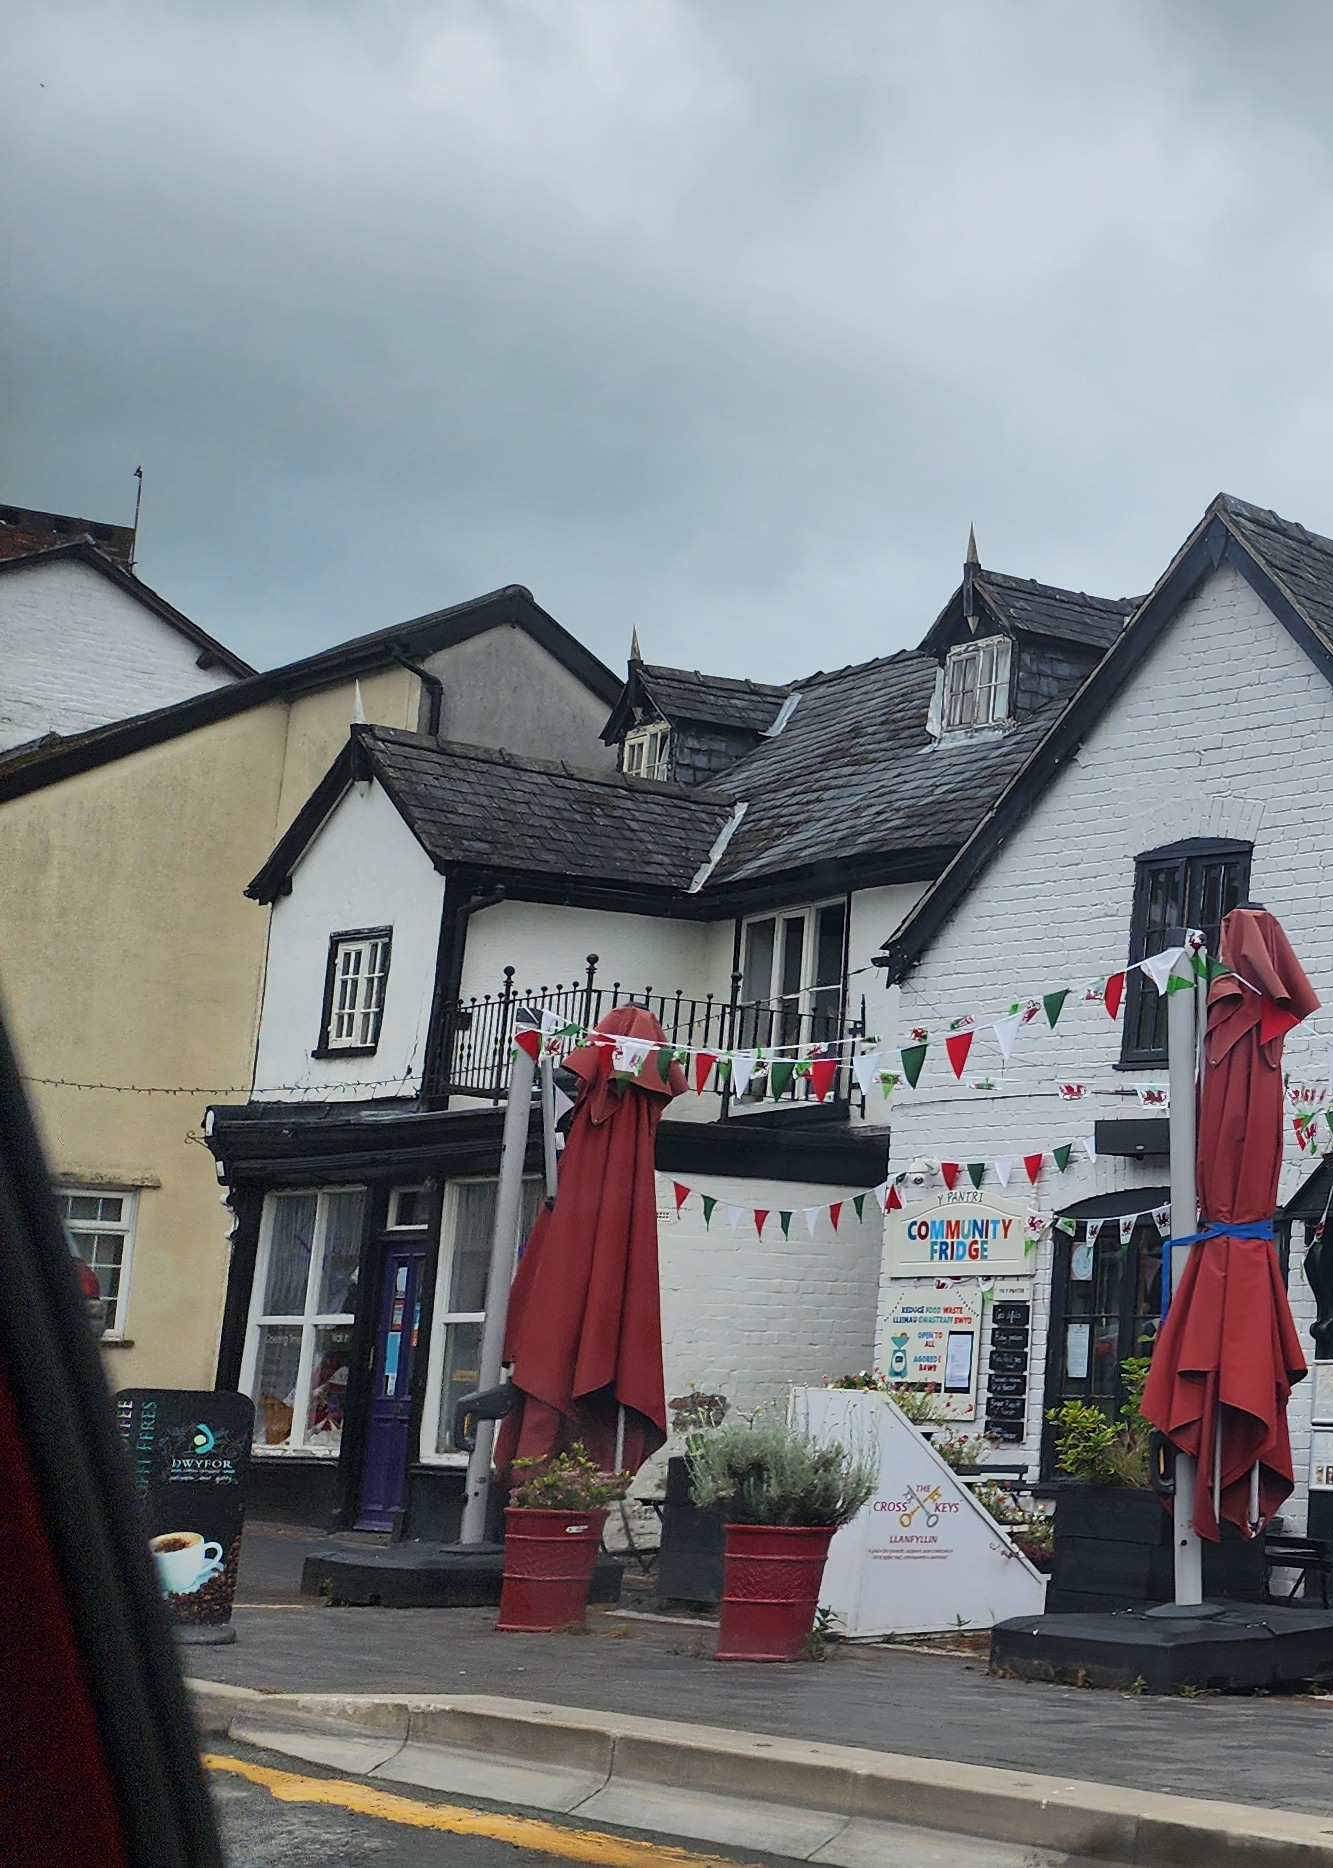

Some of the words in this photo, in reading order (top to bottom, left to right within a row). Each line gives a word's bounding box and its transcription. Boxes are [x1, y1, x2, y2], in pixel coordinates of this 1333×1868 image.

[937, 1195, 943, 1206] Y
[947, 1190, 984, 1203] PANTRI
[907, 1219, 1013, 1240] COMMUNITY
[929, 1240, 988, 1260] FRIDGE
[901, 1306, 925, 1314] REDUCE
[925, 1306, 941, 1314] FOOD
[943, 1306, 963, 1314] WASTE
[917, 1331, 933, 1339] OPEN
[934, 1331, 943, 1339] TO
[172, 1458, 233, 1469] DWYFOR
[916, 1484, 931, 1493] THE
[873, 1501, 908, 1512] CROSS
[934, 1502, 959, 1513] KEYS
[889, 1535, 938, 1543] LLANFYLLIN
